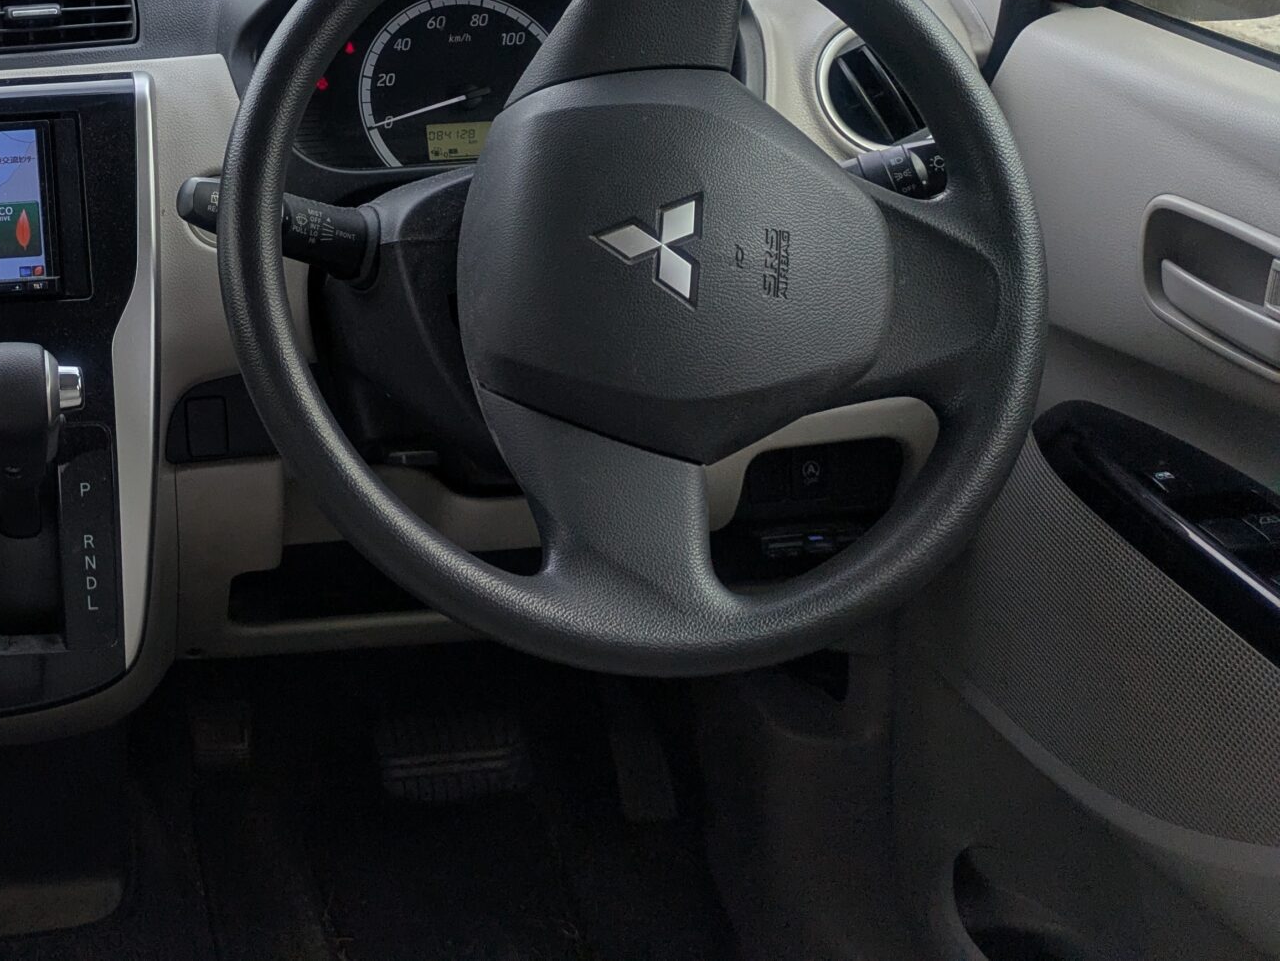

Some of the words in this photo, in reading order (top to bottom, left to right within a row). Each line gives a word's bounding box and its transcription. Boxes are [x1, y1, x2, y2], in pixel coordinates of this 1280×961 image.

[426, 15, 446, 29] 60
[470, 13, 489, 27] 80
[394, 38, 411, 51] 40
[448, 33, 472, 44] km/h
[501, 31, 526, 46] 100
[377, 73, 396, 87] 20
[384, 115, 394, 129] 0
[336, 229, 356, 240] FRONT
[763, 228, 778, 297] SRS
[80, 482, 90, 497] P
[83, 534, 95, 549] R
[85, 555, 96, 570] N
[86, 576, 97, 590] D
[87, 595, 99, 610] L
